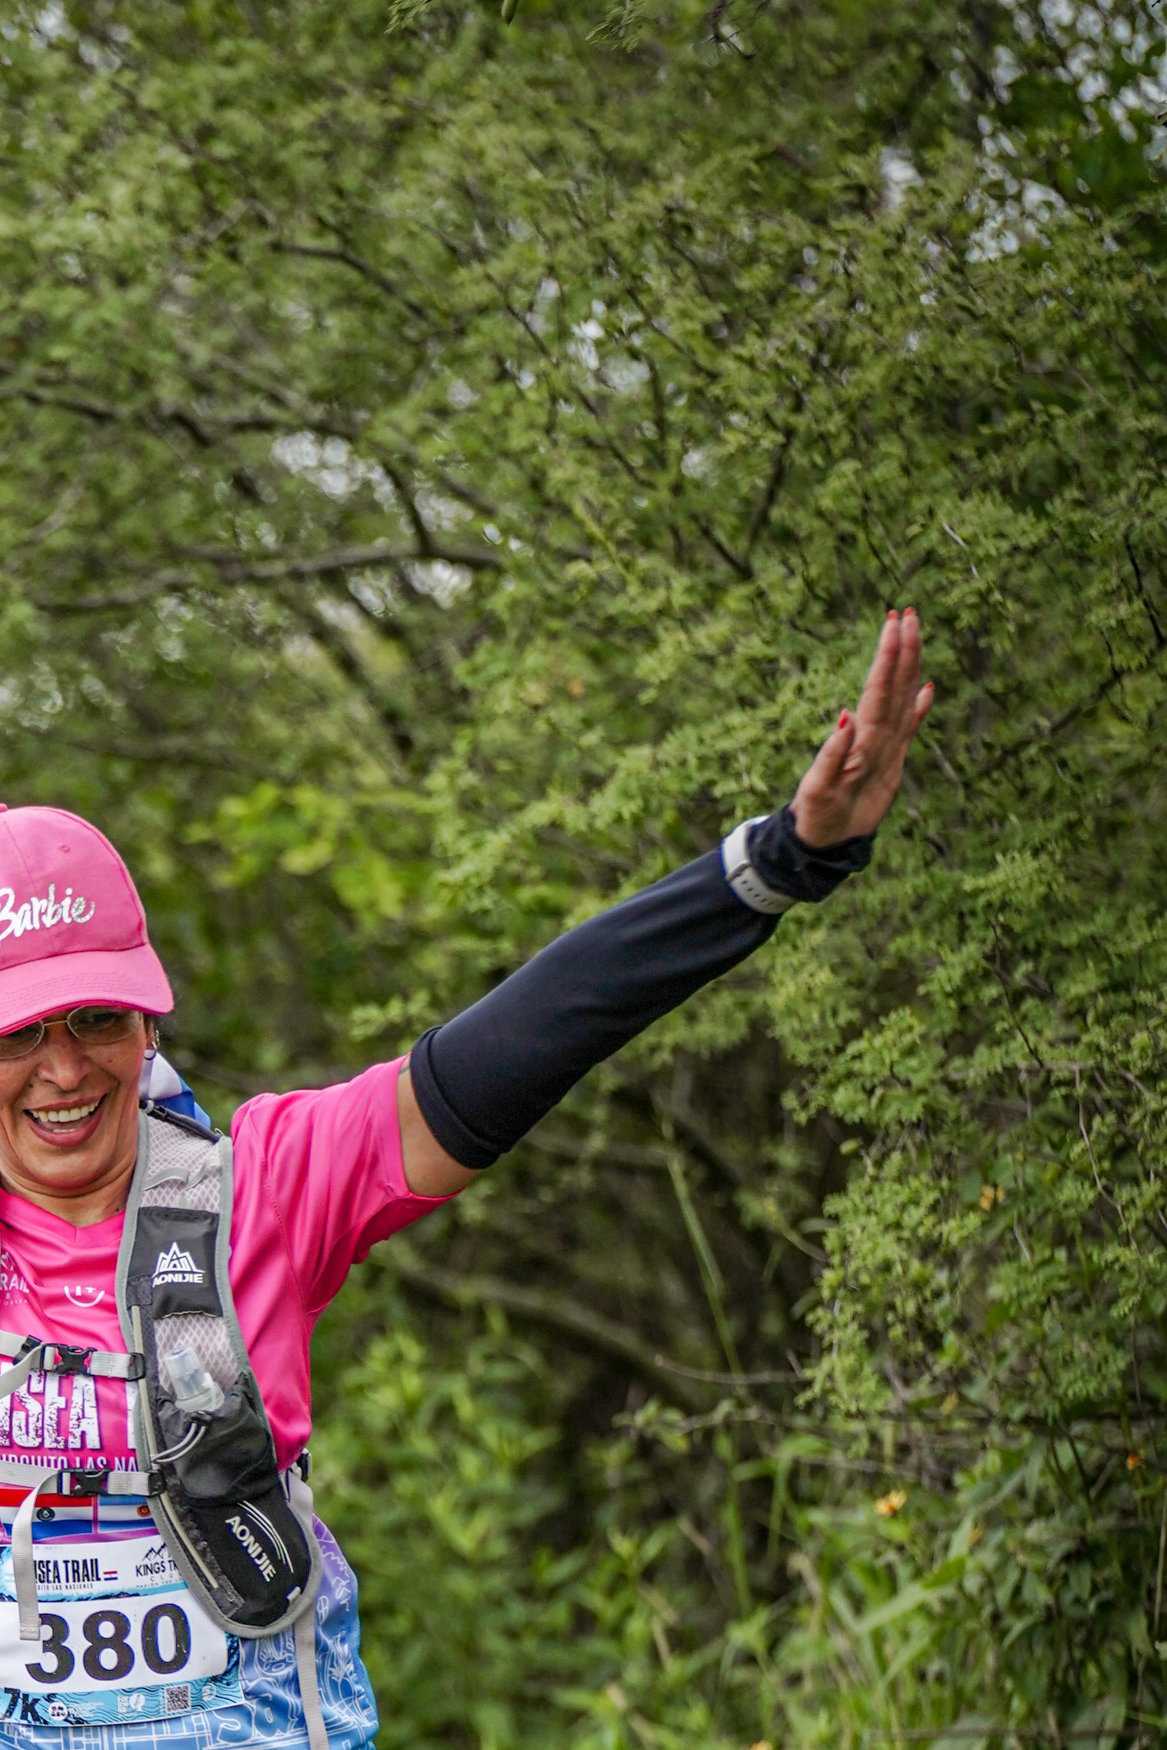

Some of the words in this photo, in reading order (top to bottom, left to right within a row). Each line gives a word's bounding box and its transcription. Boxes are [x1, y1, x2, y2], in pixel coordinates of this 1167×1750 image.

[152, 1273, 204, 1288] AONIJIE
[225, 1516, 276, 1582] AONIJIE
[63, 1558, 101, 1583] TRAIL
[135, 1560, 166, 1577] KINGS
[25, 1603, 191, 1684] 380
